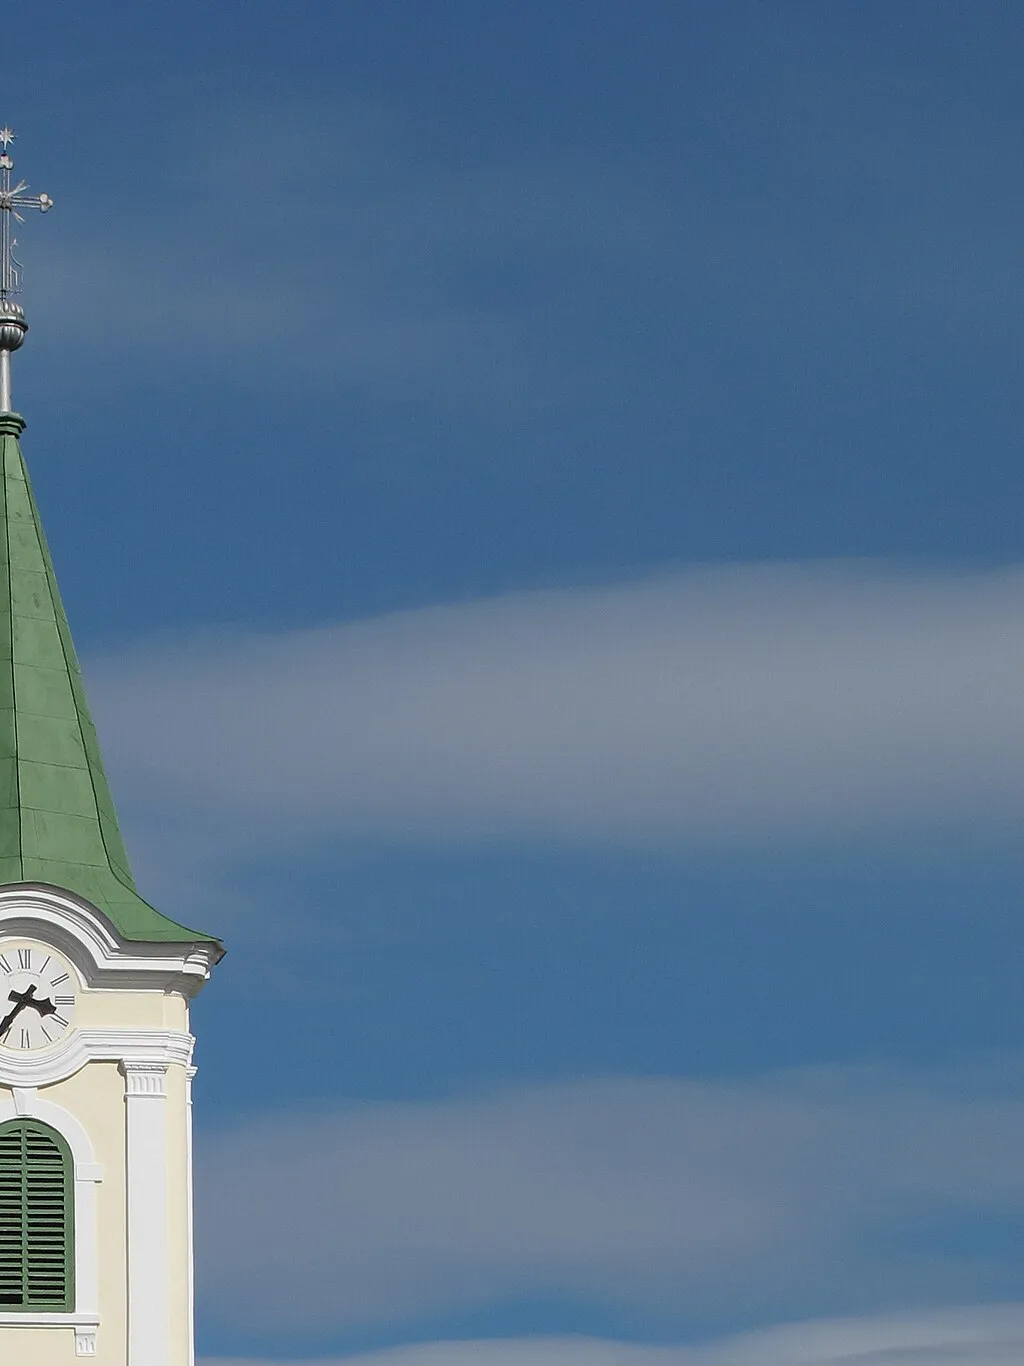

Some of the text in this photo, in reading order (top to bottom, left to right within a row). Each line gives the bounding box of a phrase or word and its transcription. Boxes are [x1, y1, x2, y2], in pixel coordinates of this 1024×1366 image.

[39, 955, 52, 974] I
[50, 972, 70, 988] II
[54, 995, 75, 1005] III
